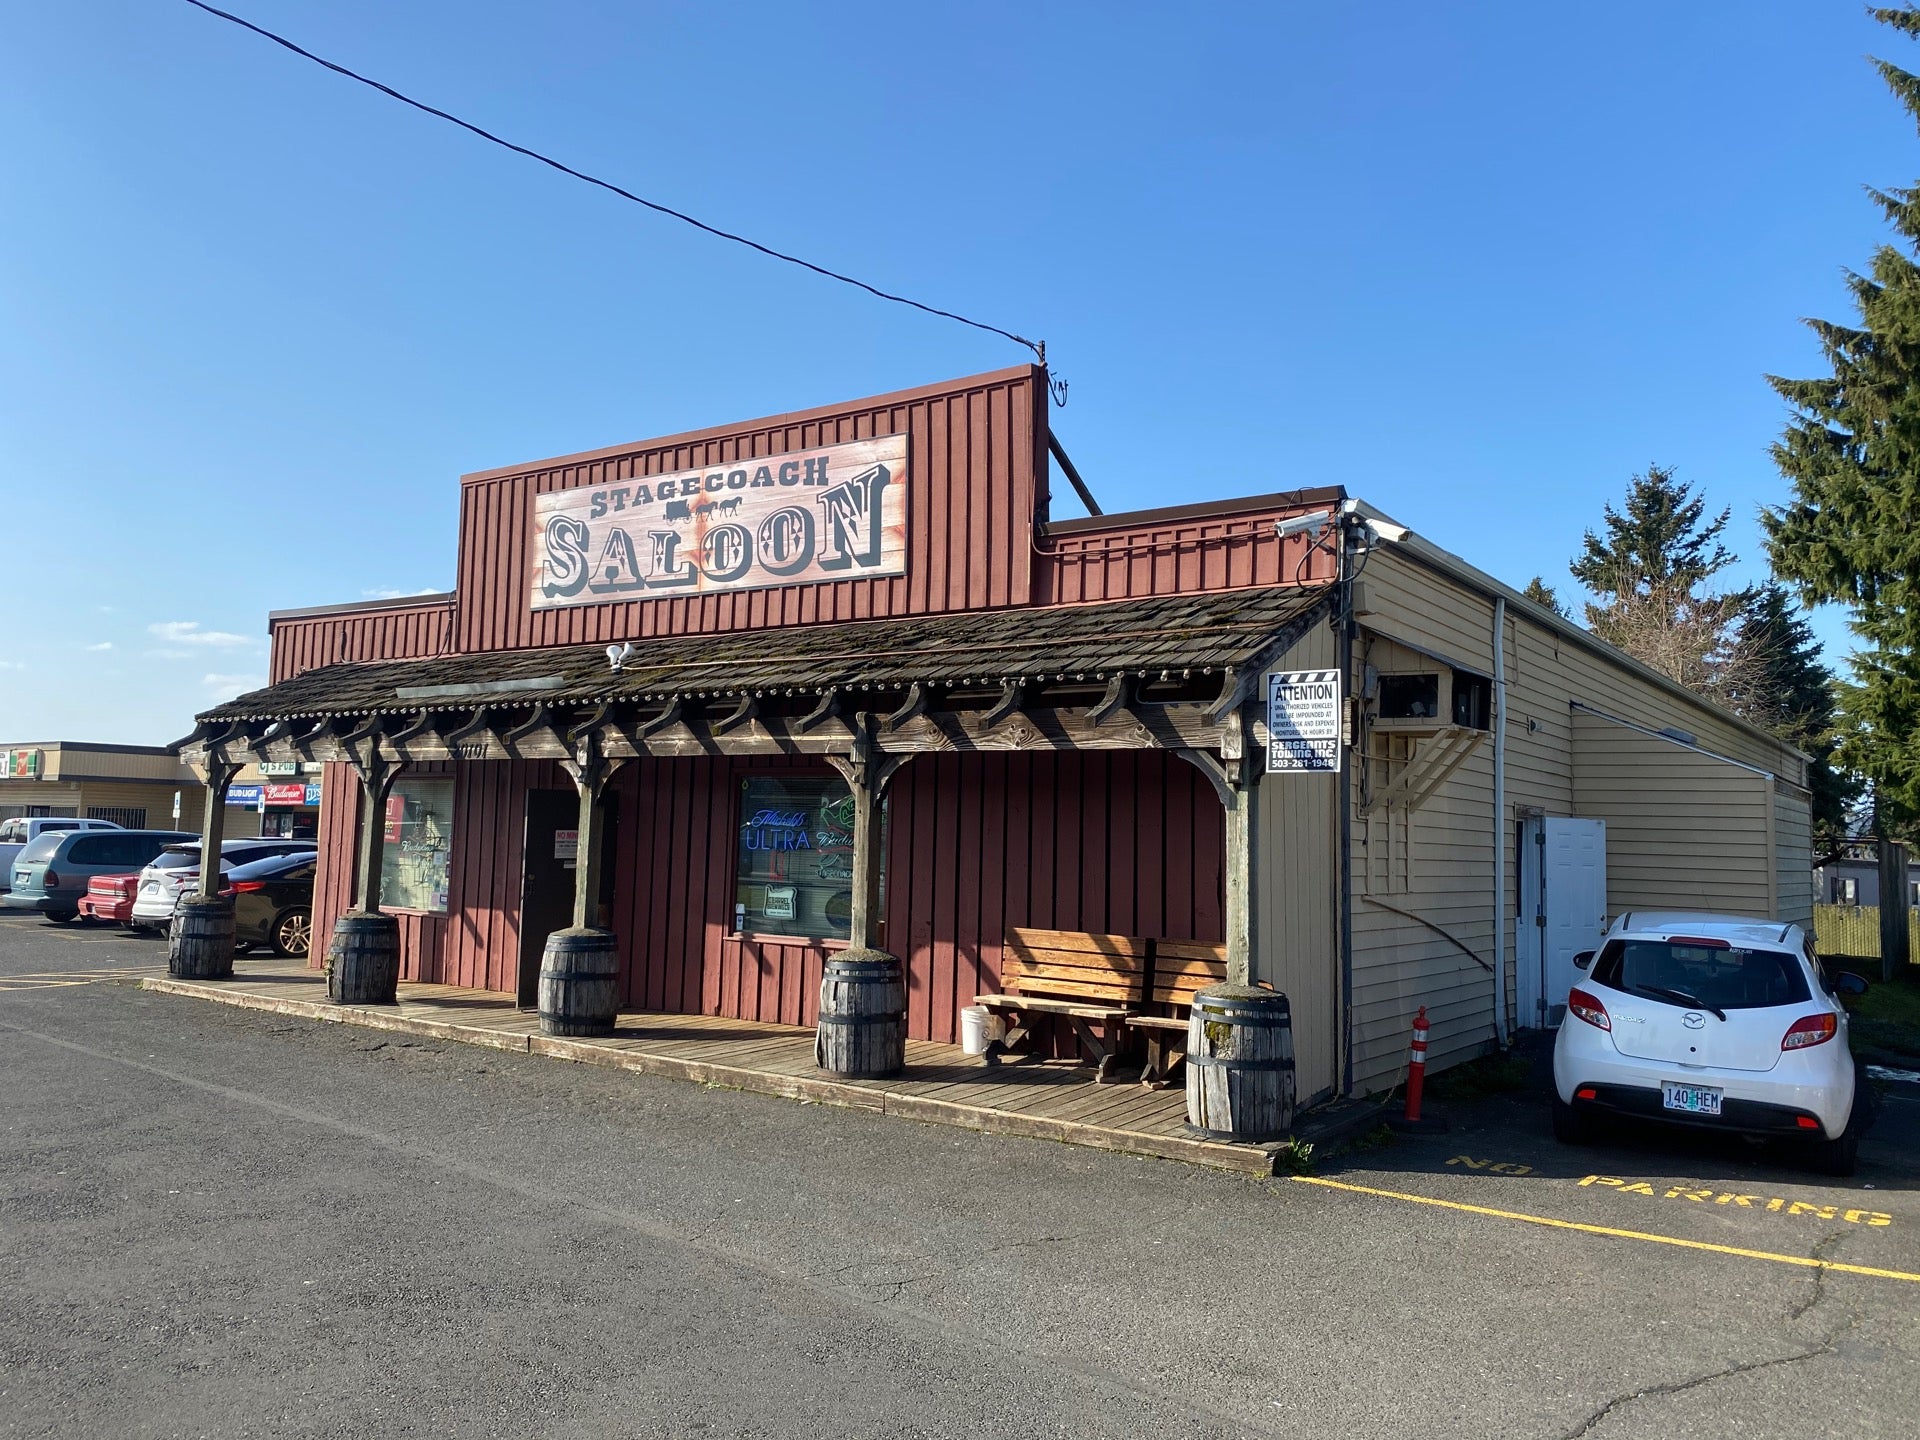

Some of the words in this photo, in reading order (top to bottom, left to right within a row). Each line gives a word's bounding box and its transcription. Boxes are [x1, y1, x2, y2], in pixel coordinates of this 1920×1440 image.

[590, 456, 830, 518] STAGECOACH
[542, 464, 891, 598] SALOON
[1275, 684, 1332, 701] ATTENTION
[1272, 740, 1336, 750] SERGEANTS
[1272, 750, 1313, 759] TOWING,
[1314, 749, 1336, 757] INC.
[278, 762, 294, 770] PUB
[1272, 759, 1334, 767] 503-281-1948
[242, 789, 258, 797] LIGHT
[267, 786, 300, 799] Budweiser
[306, 788, 321, 800] ELYS
[746, 829, 810, 850] ULTRA
[1666, 1088, 1688, 1104] 140
[1697, 1092, 1718, 1109] HEM
[1446, 1154, 1534, 1176] NO
[1577, 1175, 1893, 1227] PARKING
